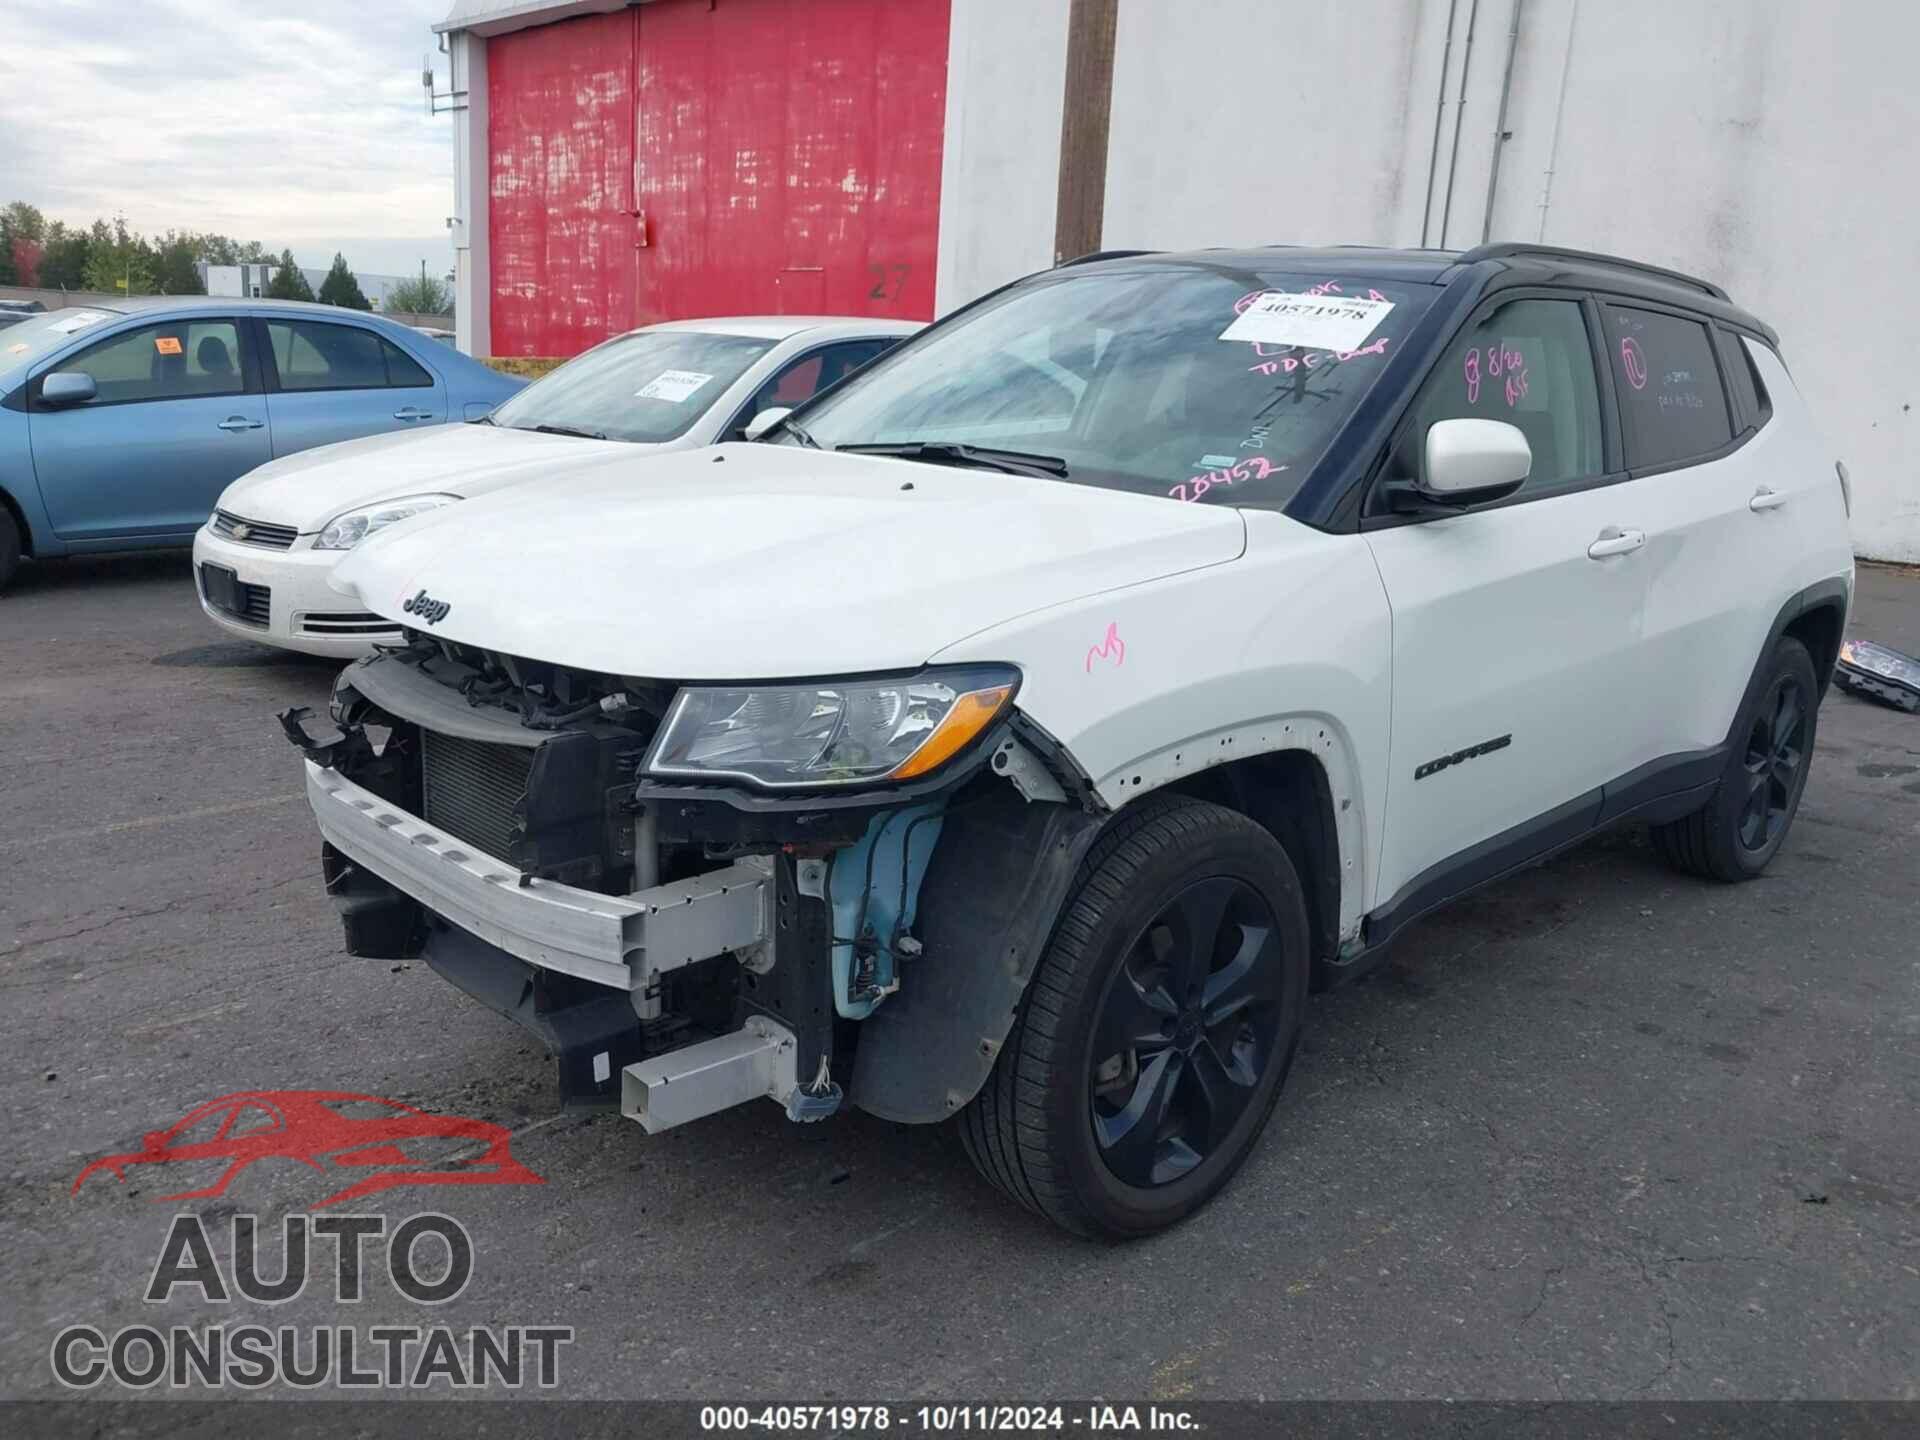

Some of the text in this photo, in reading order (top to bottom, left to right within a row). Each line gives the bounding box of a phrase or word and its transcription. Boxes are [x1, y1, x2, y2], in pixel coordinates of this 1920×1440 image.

[867, 263, 912, 300] 27
[1262, 303, 1368, 321] 40571978
[403, 589, 451, 625] Jeep
